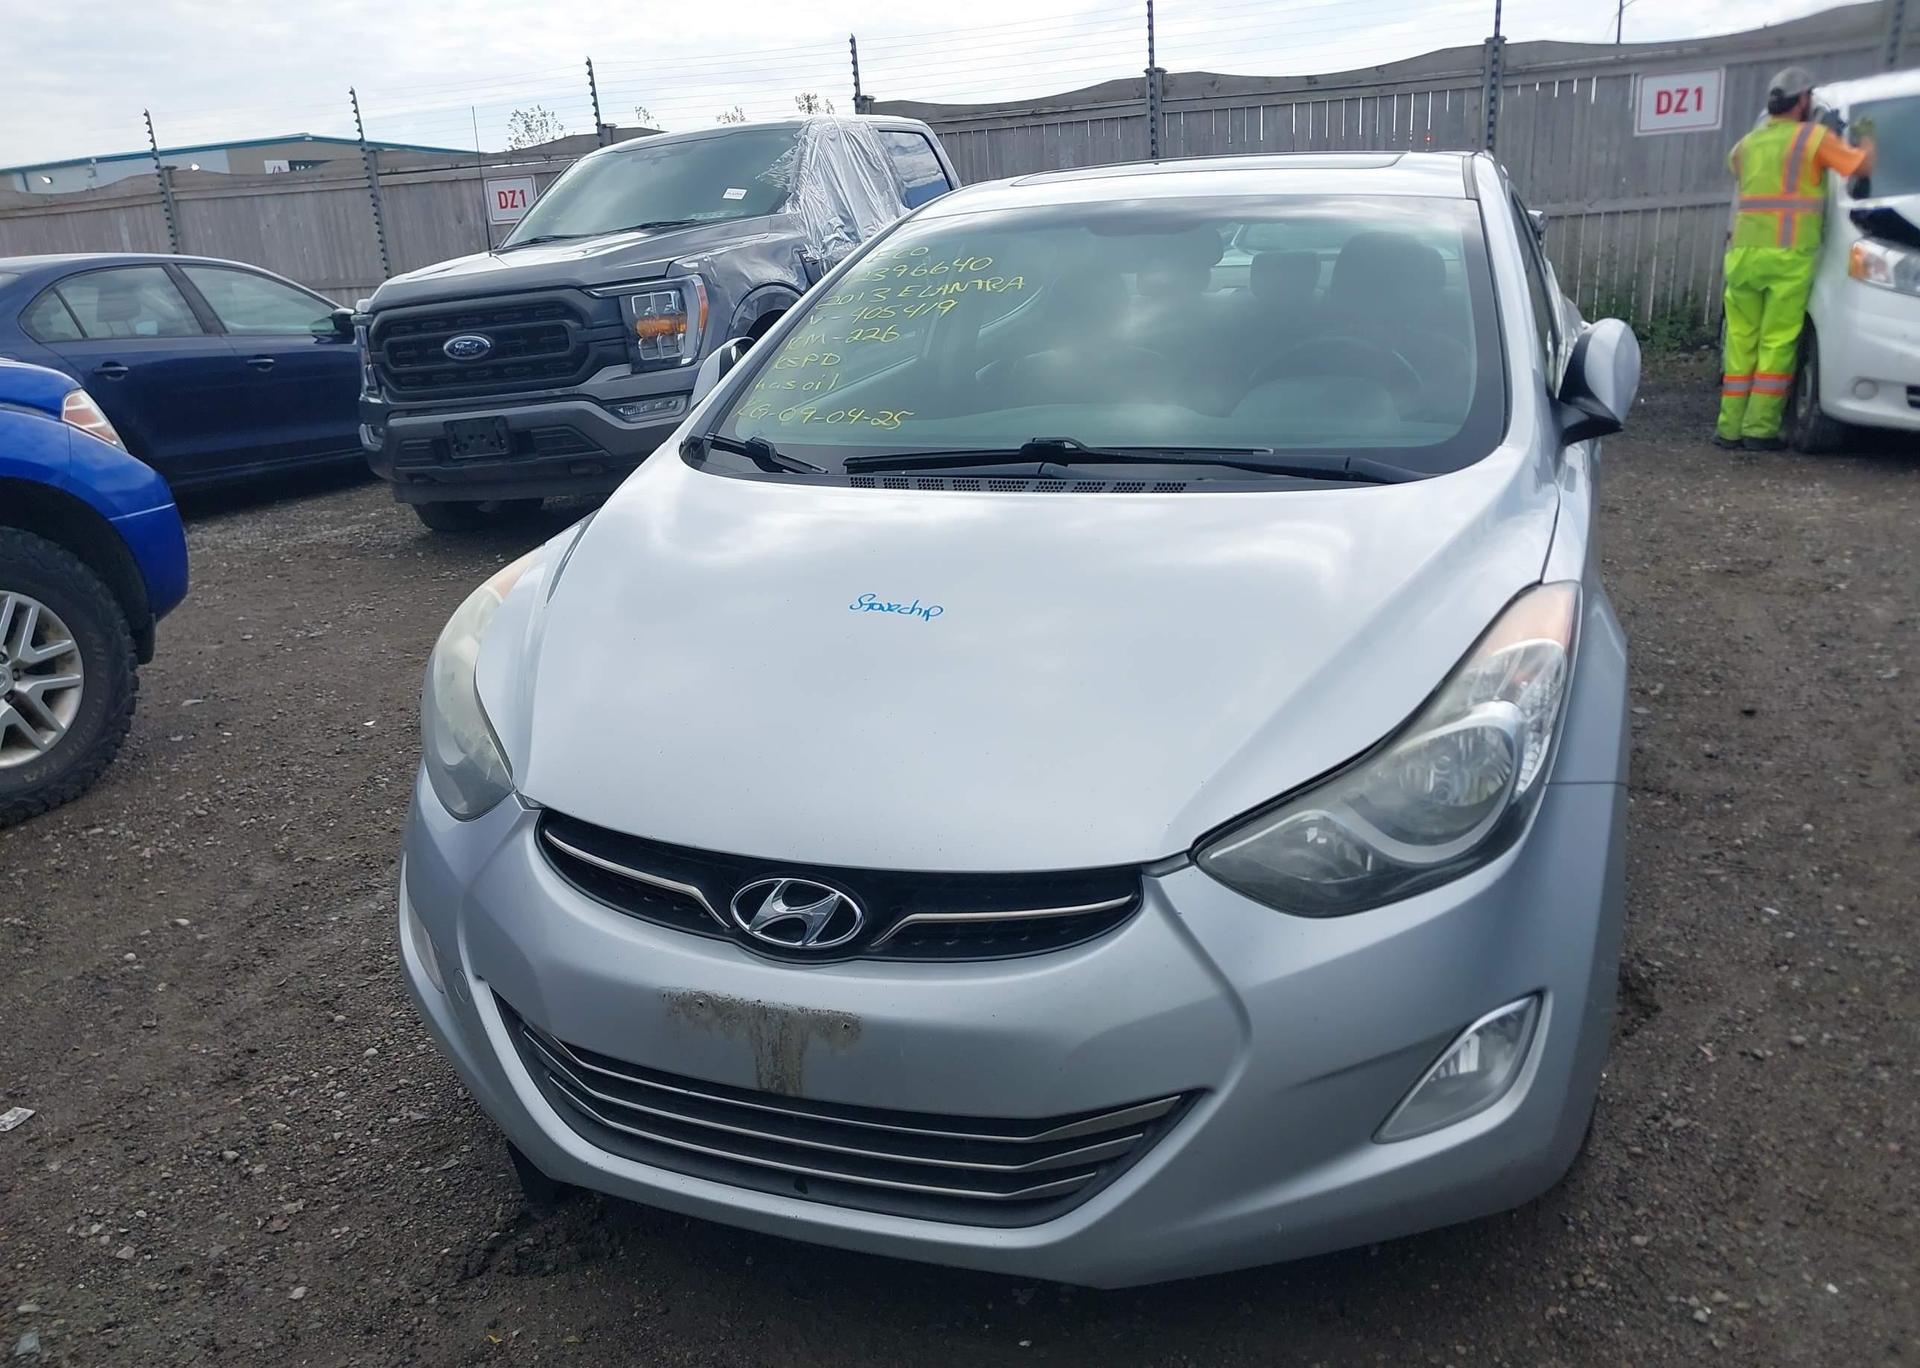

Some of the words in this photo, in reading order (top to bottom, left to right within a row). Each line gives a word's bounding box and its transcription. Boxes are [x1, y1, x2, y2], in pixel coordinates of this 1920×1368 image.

[1655, 86, 1703, 115] DZ1
[497, 190, 526, 209] DZ1
[816, 288, 891, 309] 2013
[898, 276, 1025, 298] ELANTRA
